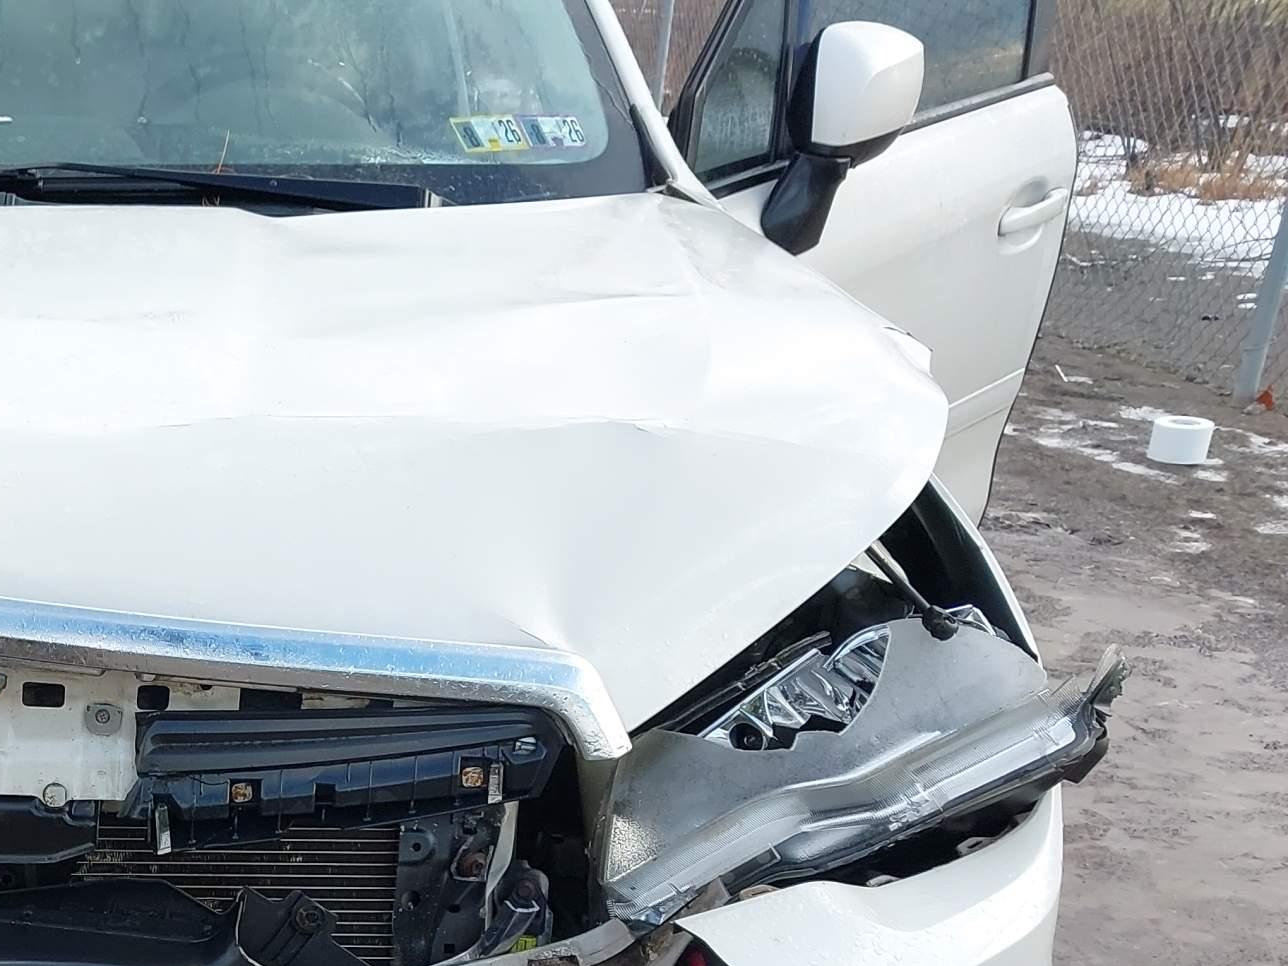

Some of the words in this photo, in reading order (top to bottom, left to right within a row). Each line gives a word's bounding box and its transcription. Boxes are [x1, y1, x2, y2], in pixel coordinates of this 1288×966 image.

[463, 123, 481, 148] 8
[499, 120, 522, 144] 26
[531, 122, 546, 146] 8
[563, 119, 585, 143] 26
